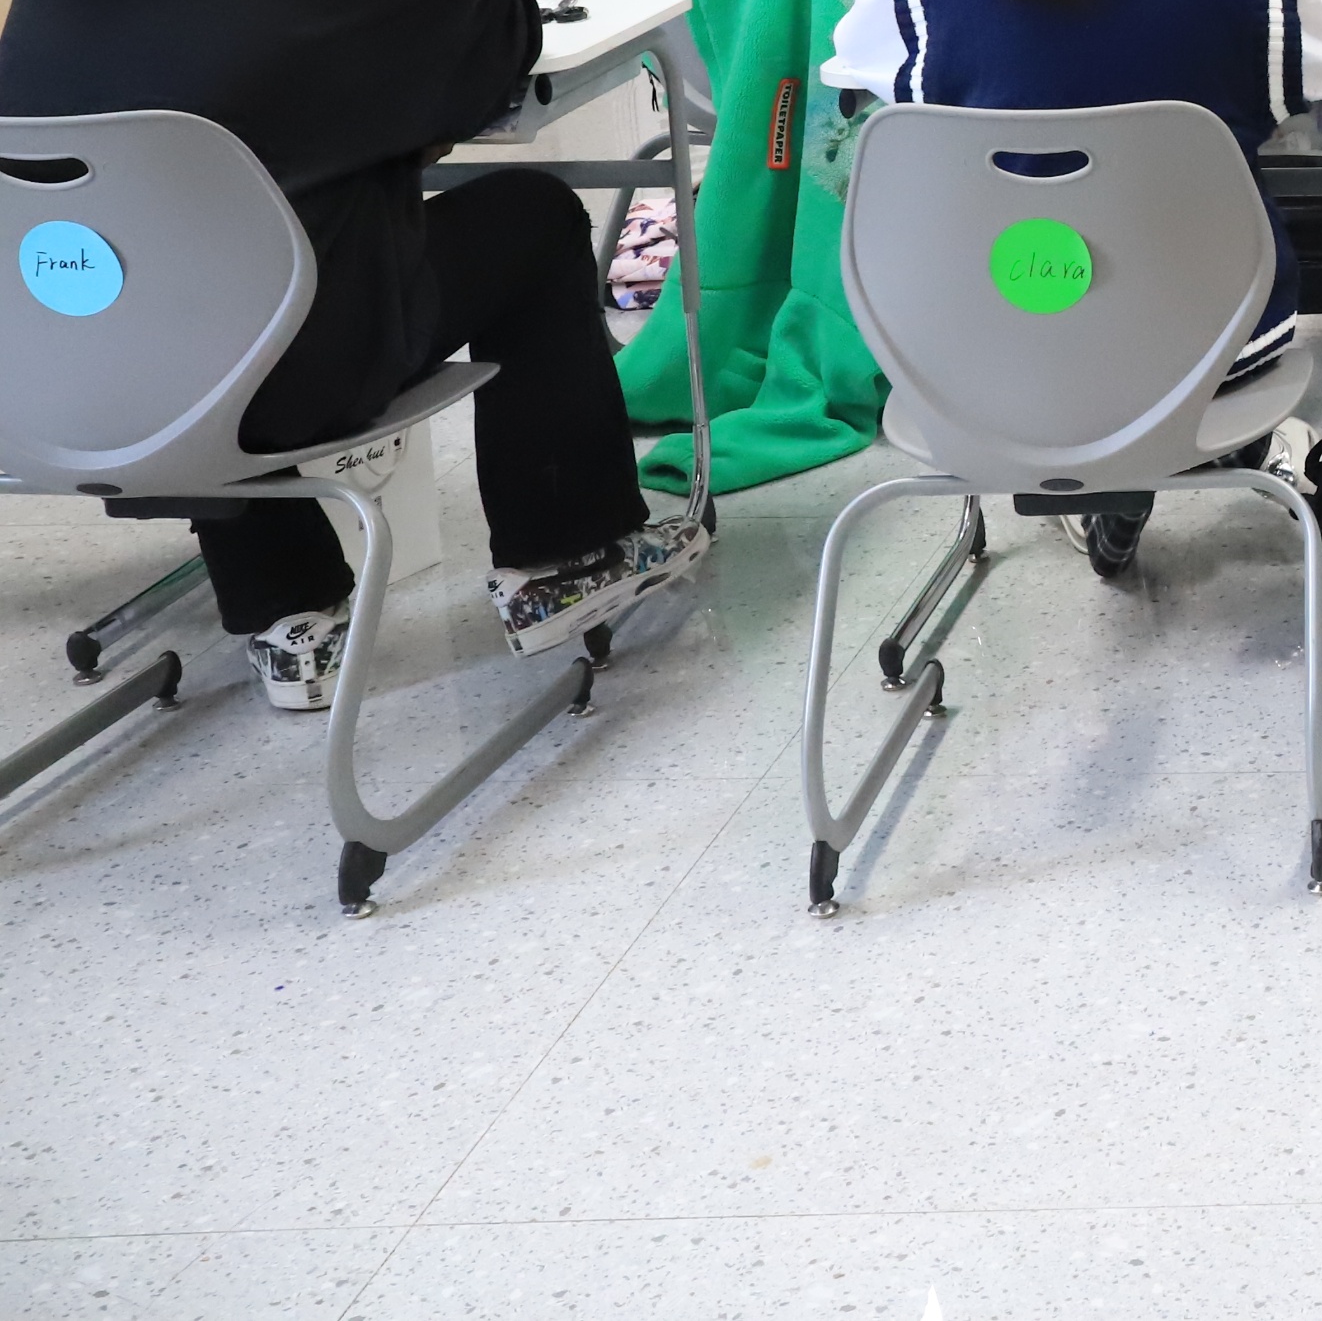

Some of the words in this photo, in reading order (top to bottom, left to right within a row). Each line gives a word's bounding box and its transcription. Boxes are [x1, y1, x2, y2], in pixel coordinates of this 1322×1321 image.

[774, 84, 792, 163] TOILETPAPER
[36, 248, 96, 277] Frank
[291, 635, 315, 647] AIR
